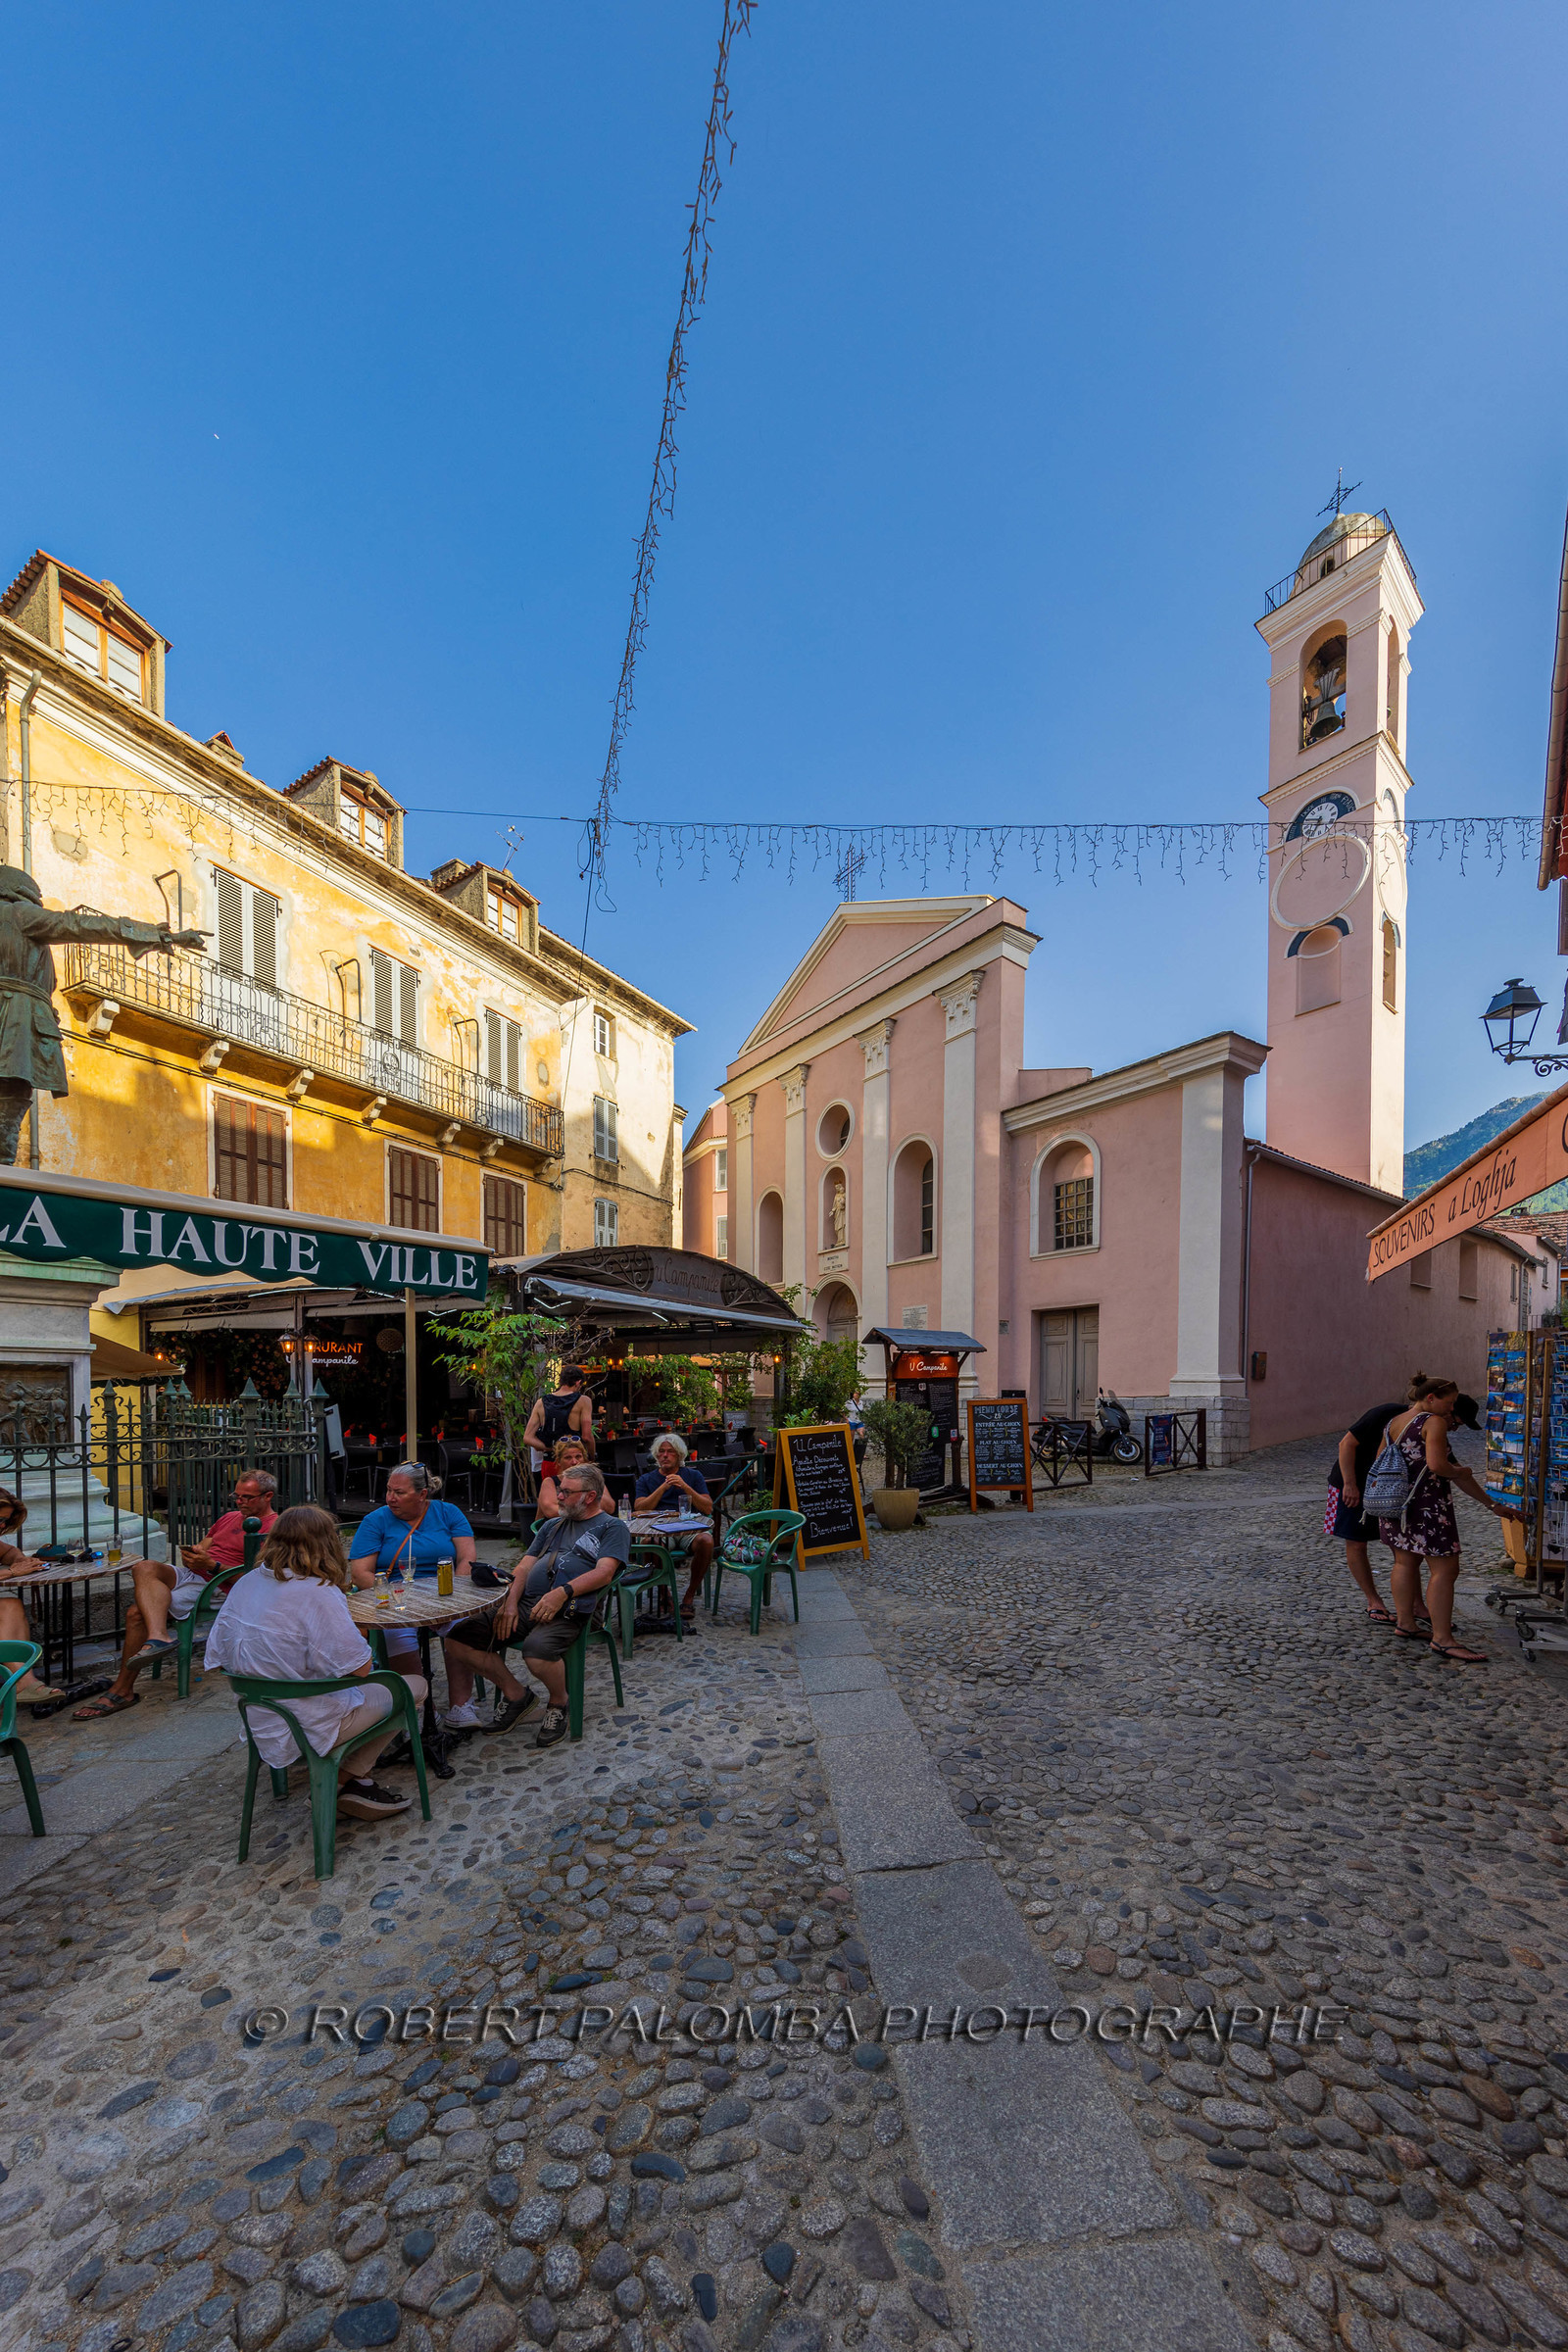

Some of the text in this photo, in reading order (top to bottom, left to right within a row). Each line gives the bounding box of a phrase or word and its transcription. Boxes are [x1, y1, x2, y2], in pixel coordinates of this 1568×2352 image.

[1373, 1202, 1435, 1267] SOUVENIRS
[1459, 1150, 1517, 1219] Loghja
[119, 1206, 320, 1274] HAUTE
[356, 1240, 479, 1290] VILLE
[664, 1256, 719, 1296] Campanile
[312, 1354, 359, 1367] ampanile
[916, 1361, 949, 1374] Campanile
[996, 1404, 1019, 1413] CORSE
[807, 1434, 843, 1454] Campanile
